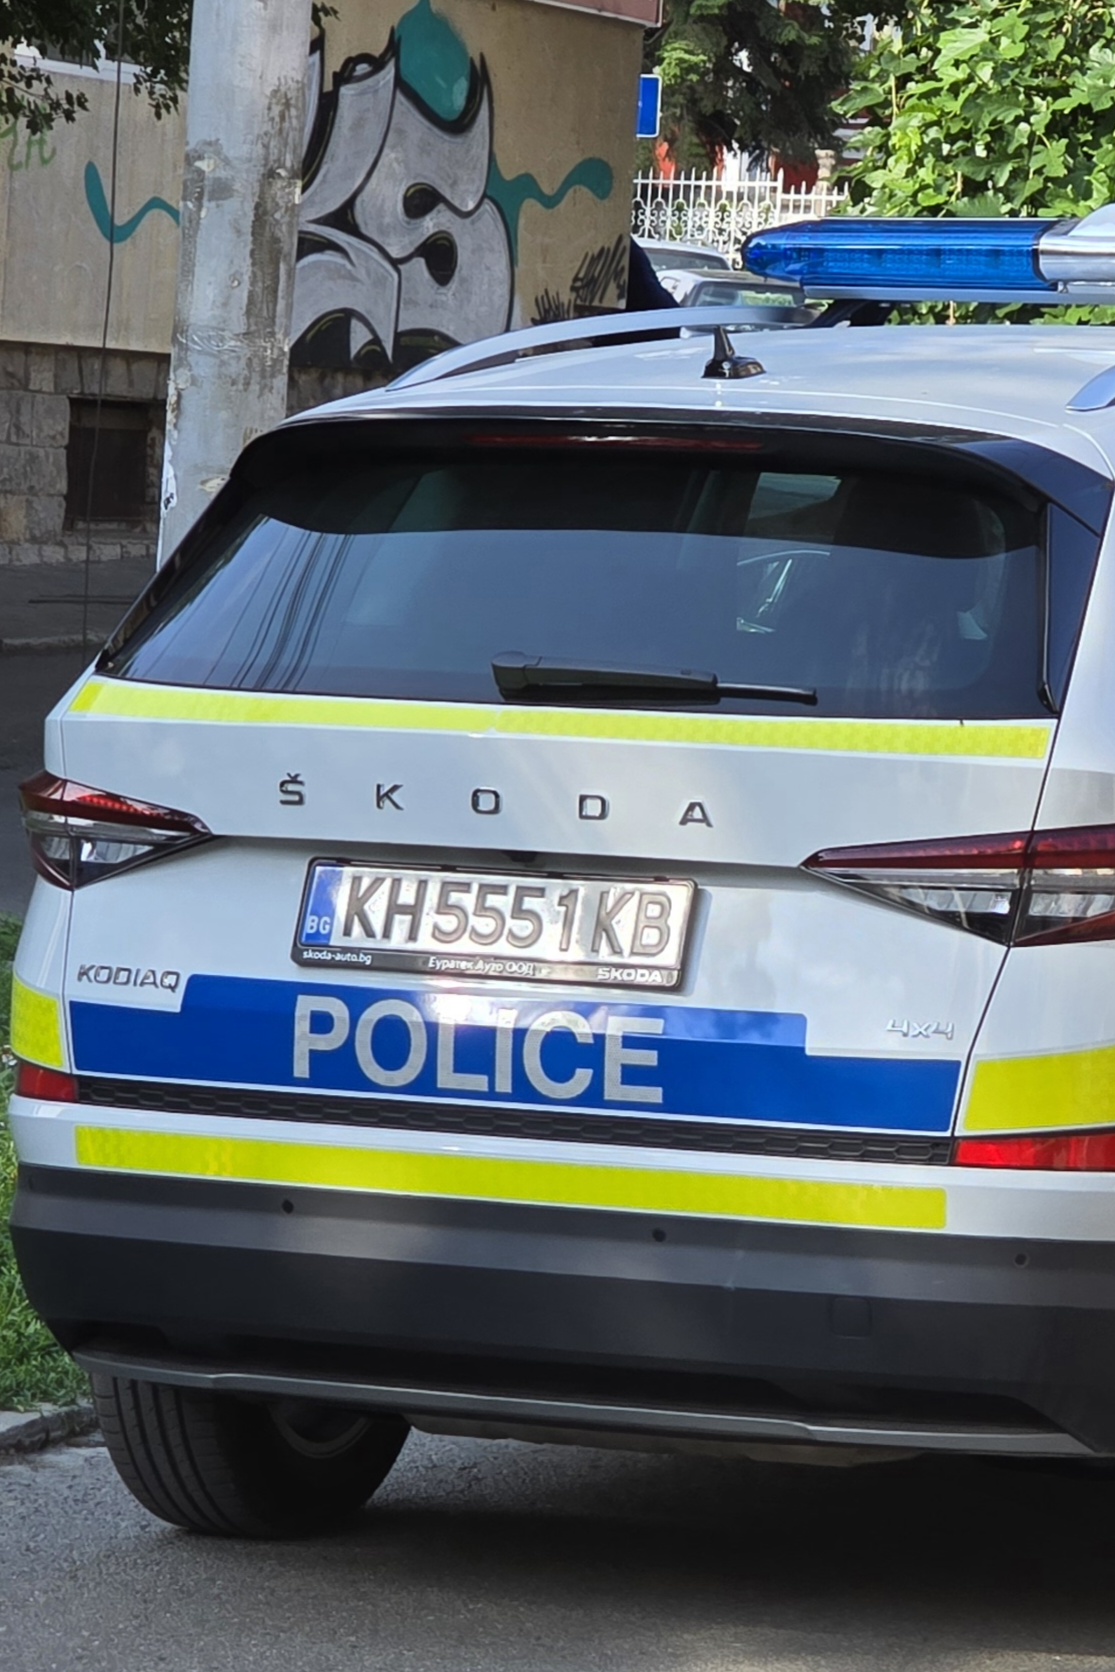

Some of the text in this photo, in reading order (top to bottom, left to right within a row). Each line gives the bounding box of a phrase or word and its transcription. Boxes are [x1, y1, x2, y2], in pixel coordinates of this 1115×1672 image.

[278, 773, 714, 828] ŠKODA
[305, 914, 331, 936] BG
[302, 949, 372, 965] skoda-auto.bg
[505, 961, 535, 976] ООД
[77, 964, 181, 993] KODIAQ
[293, 994, 665, 1104] POLICE
